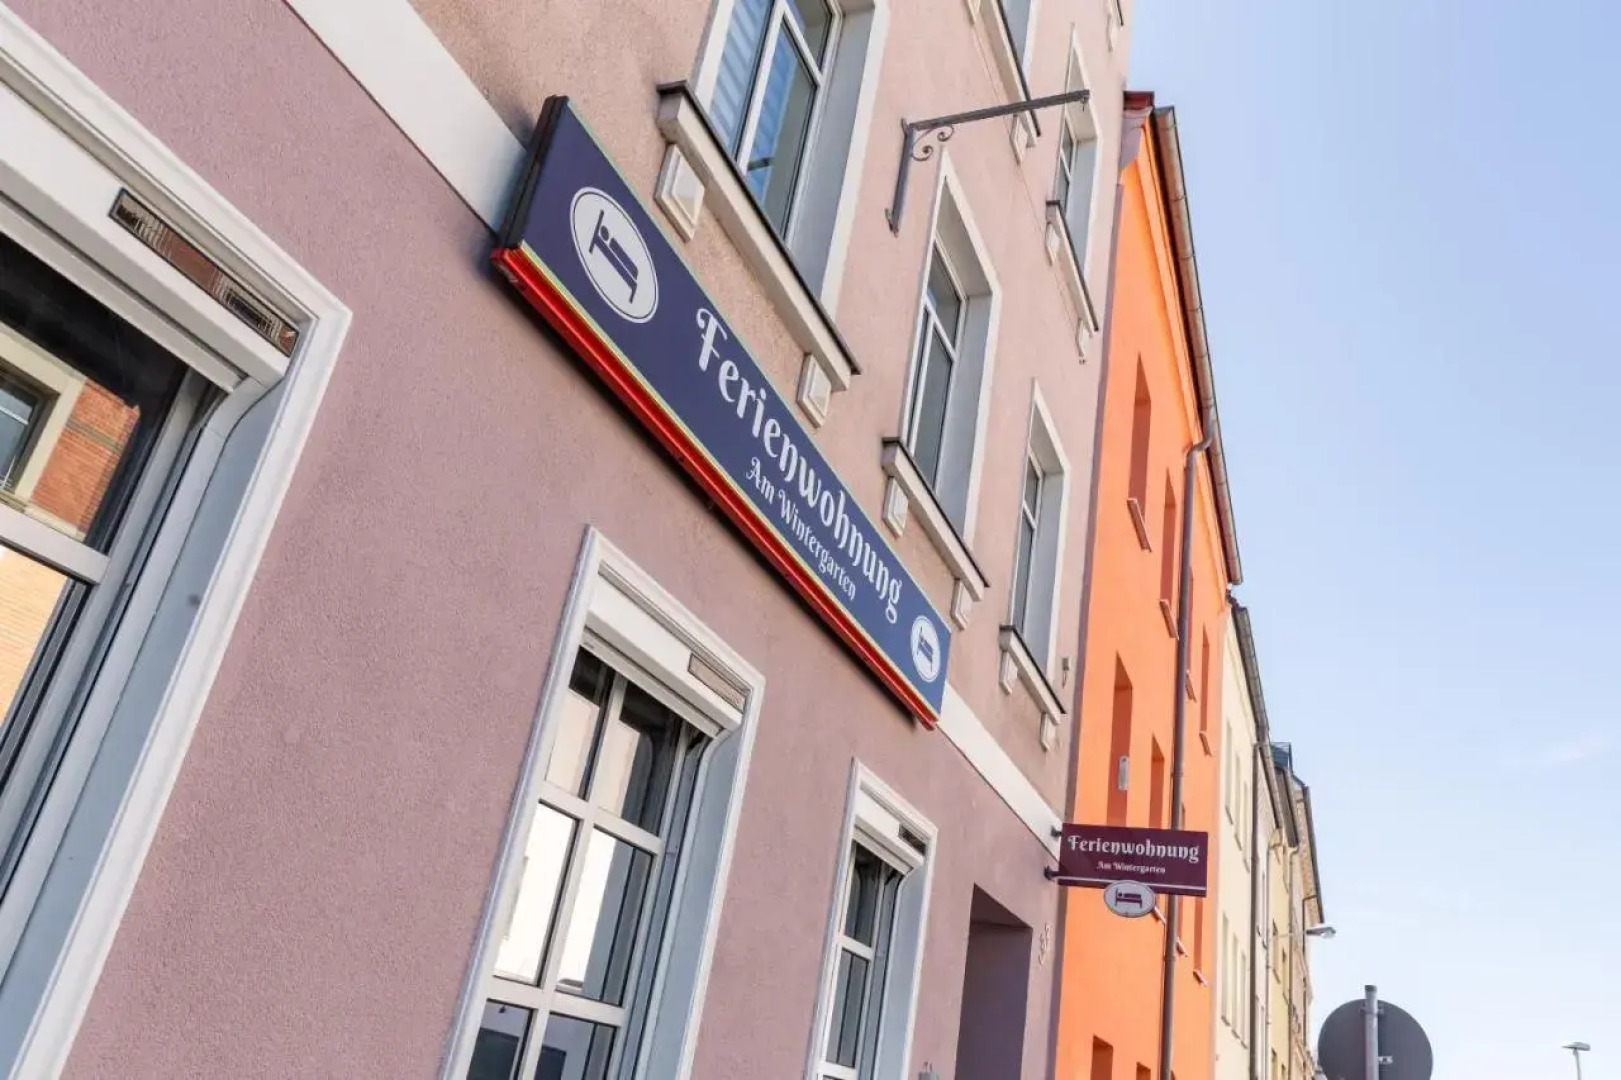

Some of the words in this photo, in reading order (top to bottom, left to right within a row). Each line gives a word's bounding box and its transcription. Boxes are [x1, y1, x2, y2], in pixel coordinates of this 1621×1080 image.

[695, 307, 903, 624] Ferienwohnung
[746, 456, 775, 505] Am
[778, 489, 856, 601] Wintergarten
[1067, 834, 1200, 863] Ferienwohnung
[1096, 861, 1112, 870] Am
[1112, 861, 1166, 875] Wintergarten
